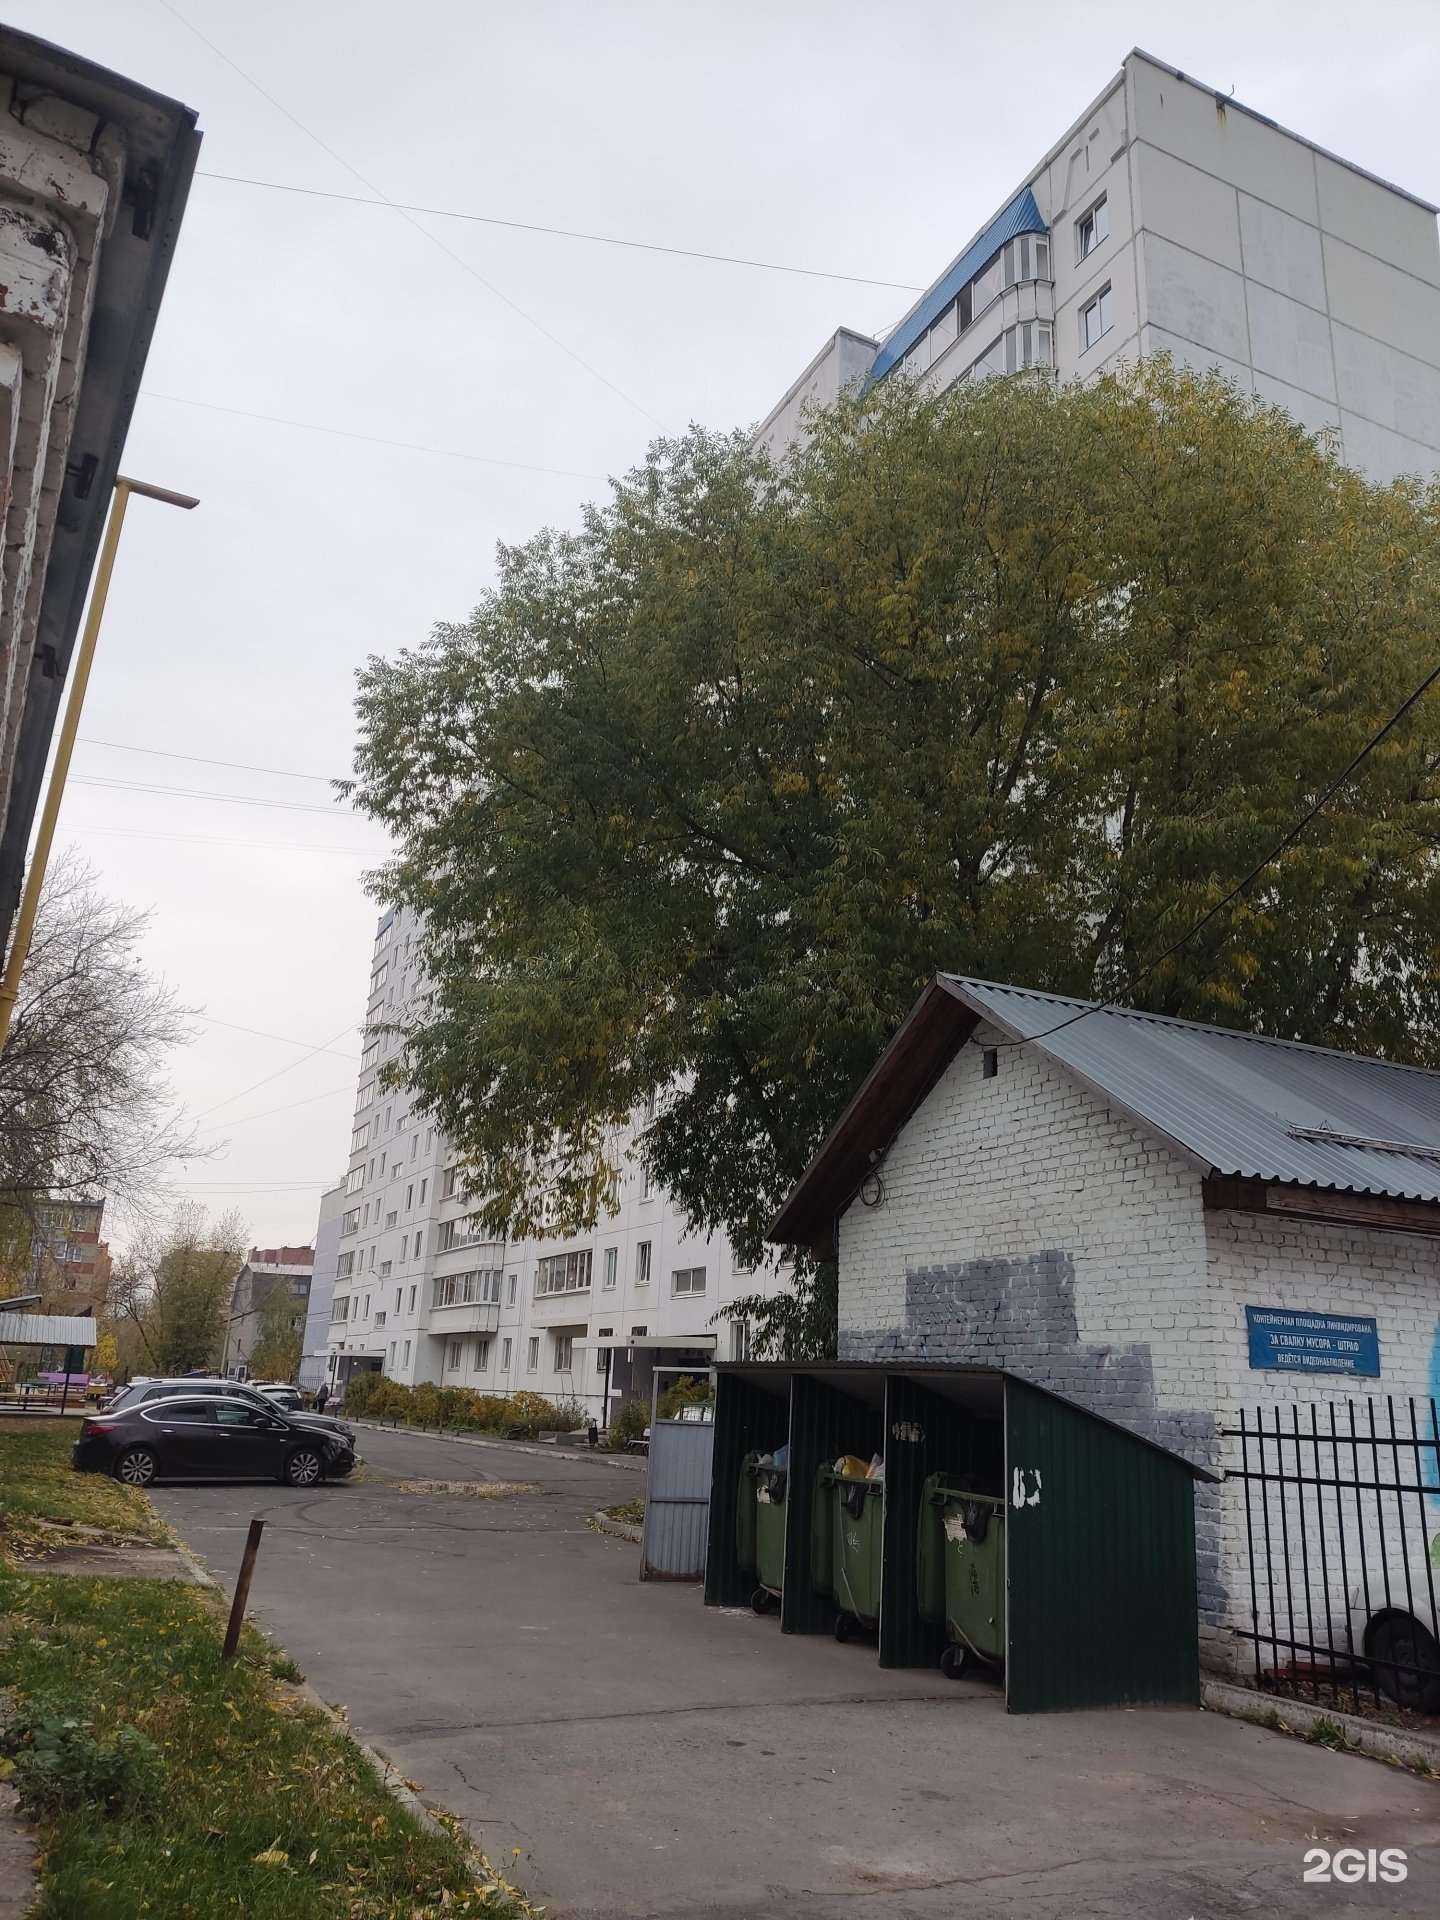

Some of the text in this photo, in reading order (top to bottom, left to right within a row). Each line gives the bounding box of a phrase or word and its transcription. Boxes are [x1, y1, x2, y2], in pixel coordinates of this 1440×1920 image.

[1296, 1318, 1326, 1330] ПЛОЩАДКА
[1270, 1334, 1279, 1345] ЗА
[1280, 1335, 1304, 1347] СВАЛКУ
[1306, 1337, 1331, 1350] МУСОРА
[1337, 1340, 1360, 1352] ШТРАФ
